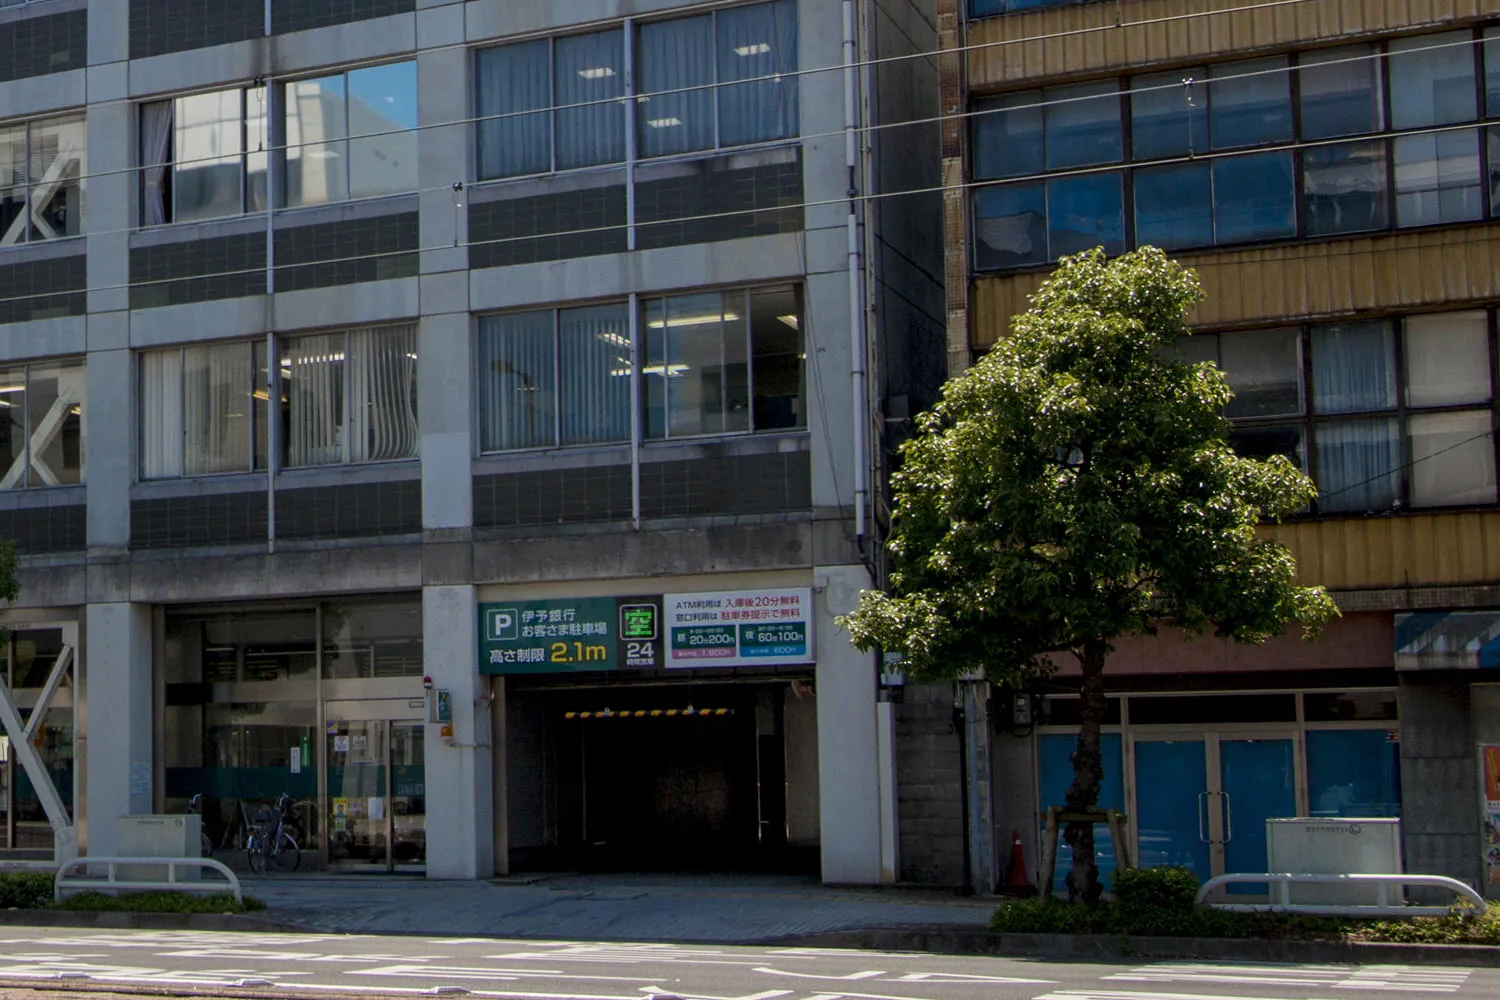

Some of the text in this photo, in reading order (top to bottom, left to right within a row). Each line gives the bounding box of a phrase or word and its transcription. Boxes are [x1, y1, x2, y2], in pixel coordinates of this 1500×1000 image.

[676, 599, 721, 610] ATM利用は
[521, 608, 577, 623] 伊予銀行
[494, 613, 512, 636] P
[522, 622, 608, 638] お客さま駐車場
[489, 641, 607, 664] 高さ制限 2.1m
[627, 642, 655, 658] 24
